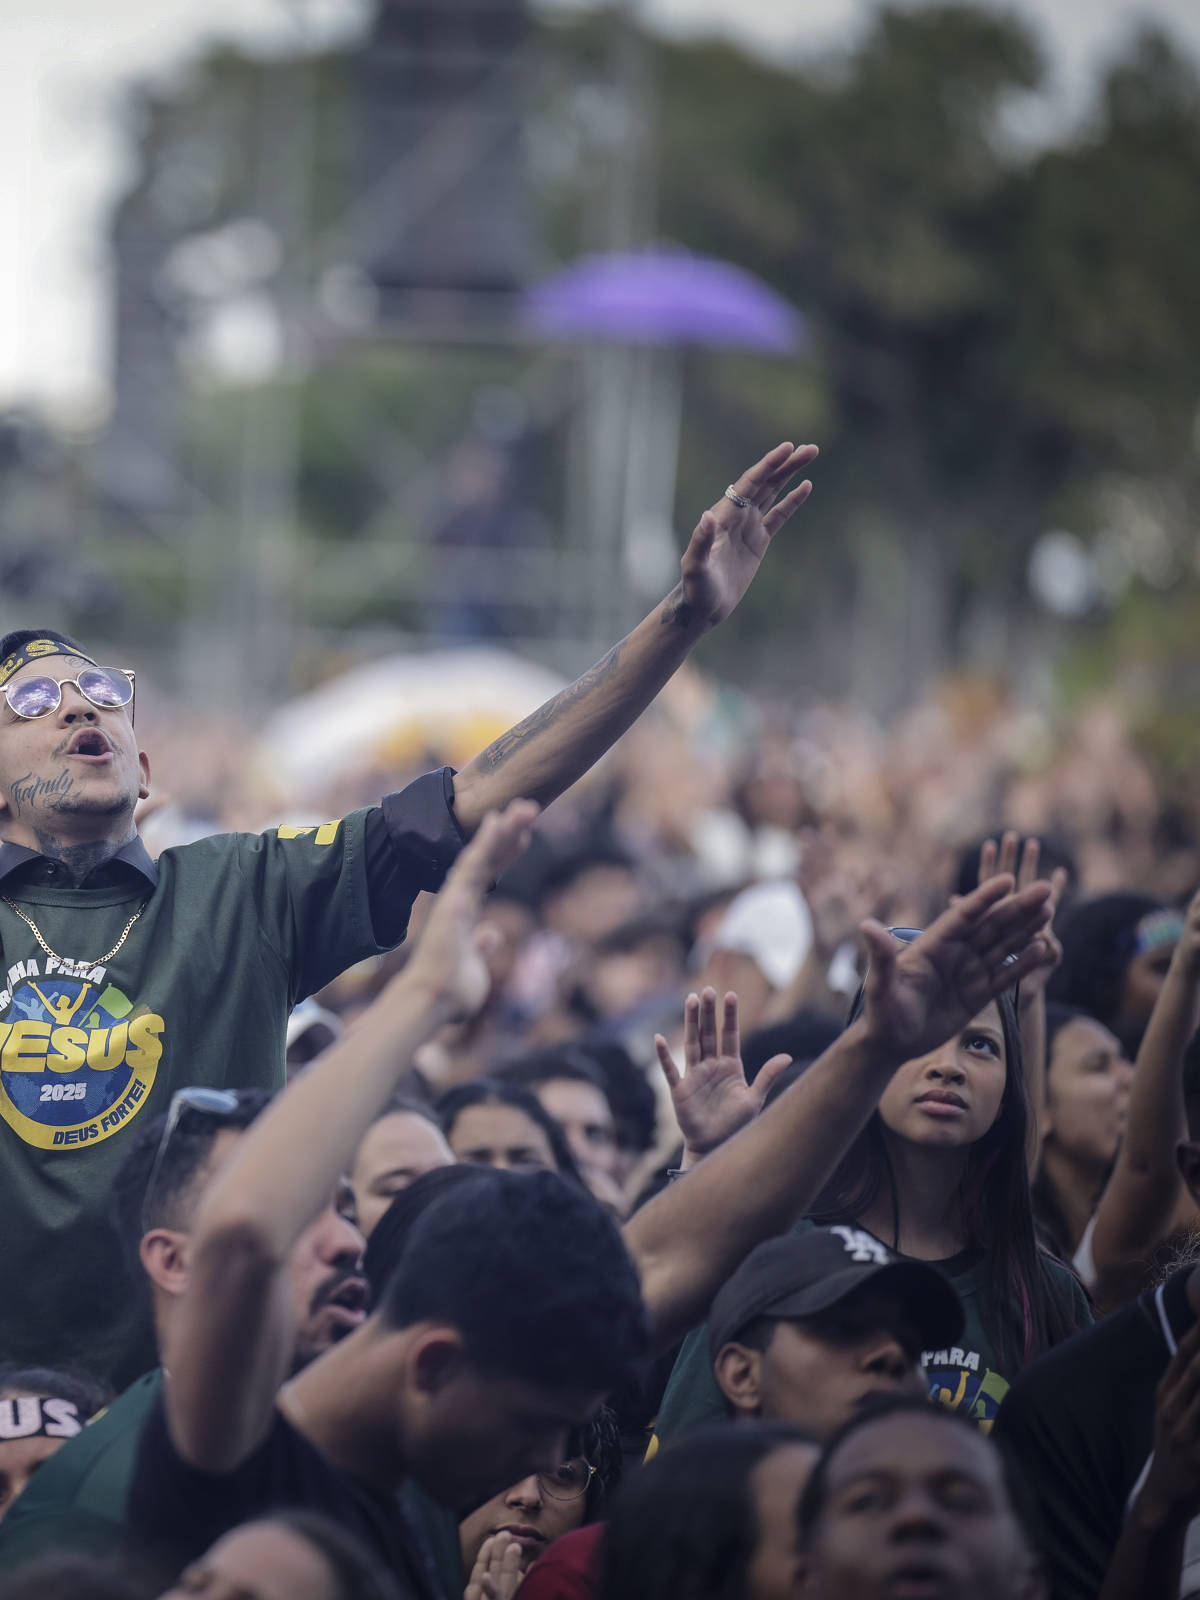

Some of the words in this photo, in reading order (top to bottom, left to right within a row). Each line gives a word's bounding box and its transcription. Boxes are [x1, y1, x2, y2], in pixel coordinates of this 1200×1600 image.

[10, 768, 79, 816] Family
[44, 957, 107, 985] PARA
[39, 1082, 88, 1102] 2025
[52, 1124, 99, 1146] DEUS
[100, 1078, 147, 1133] FORTE!
[829, 1224, 891, 1266] LA
[920, 1346, 981, 1372] PARA
